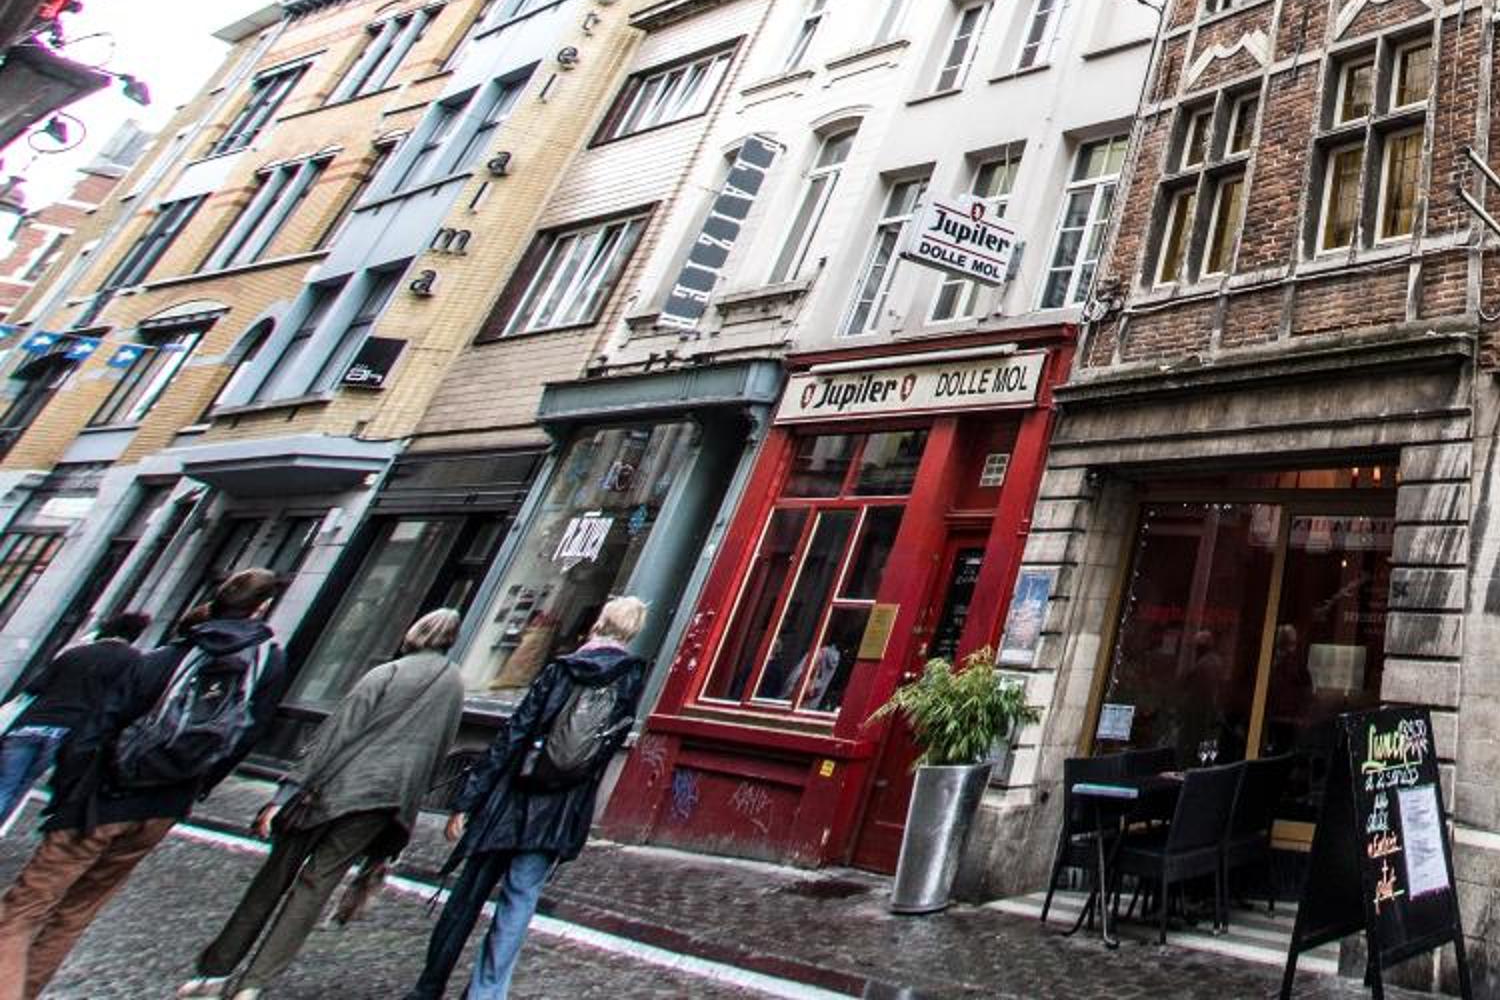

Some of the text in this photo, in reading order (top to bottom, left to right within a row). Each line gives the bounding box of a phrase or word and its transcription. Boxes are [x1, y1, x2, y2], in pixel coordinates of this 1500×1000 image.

[928, 209, 1010, 253] Jupiler
[919, 241, 1001, 279] DOLLE MOL
[814, 365, 1028, 411] Jupiler DOLLE MOL
